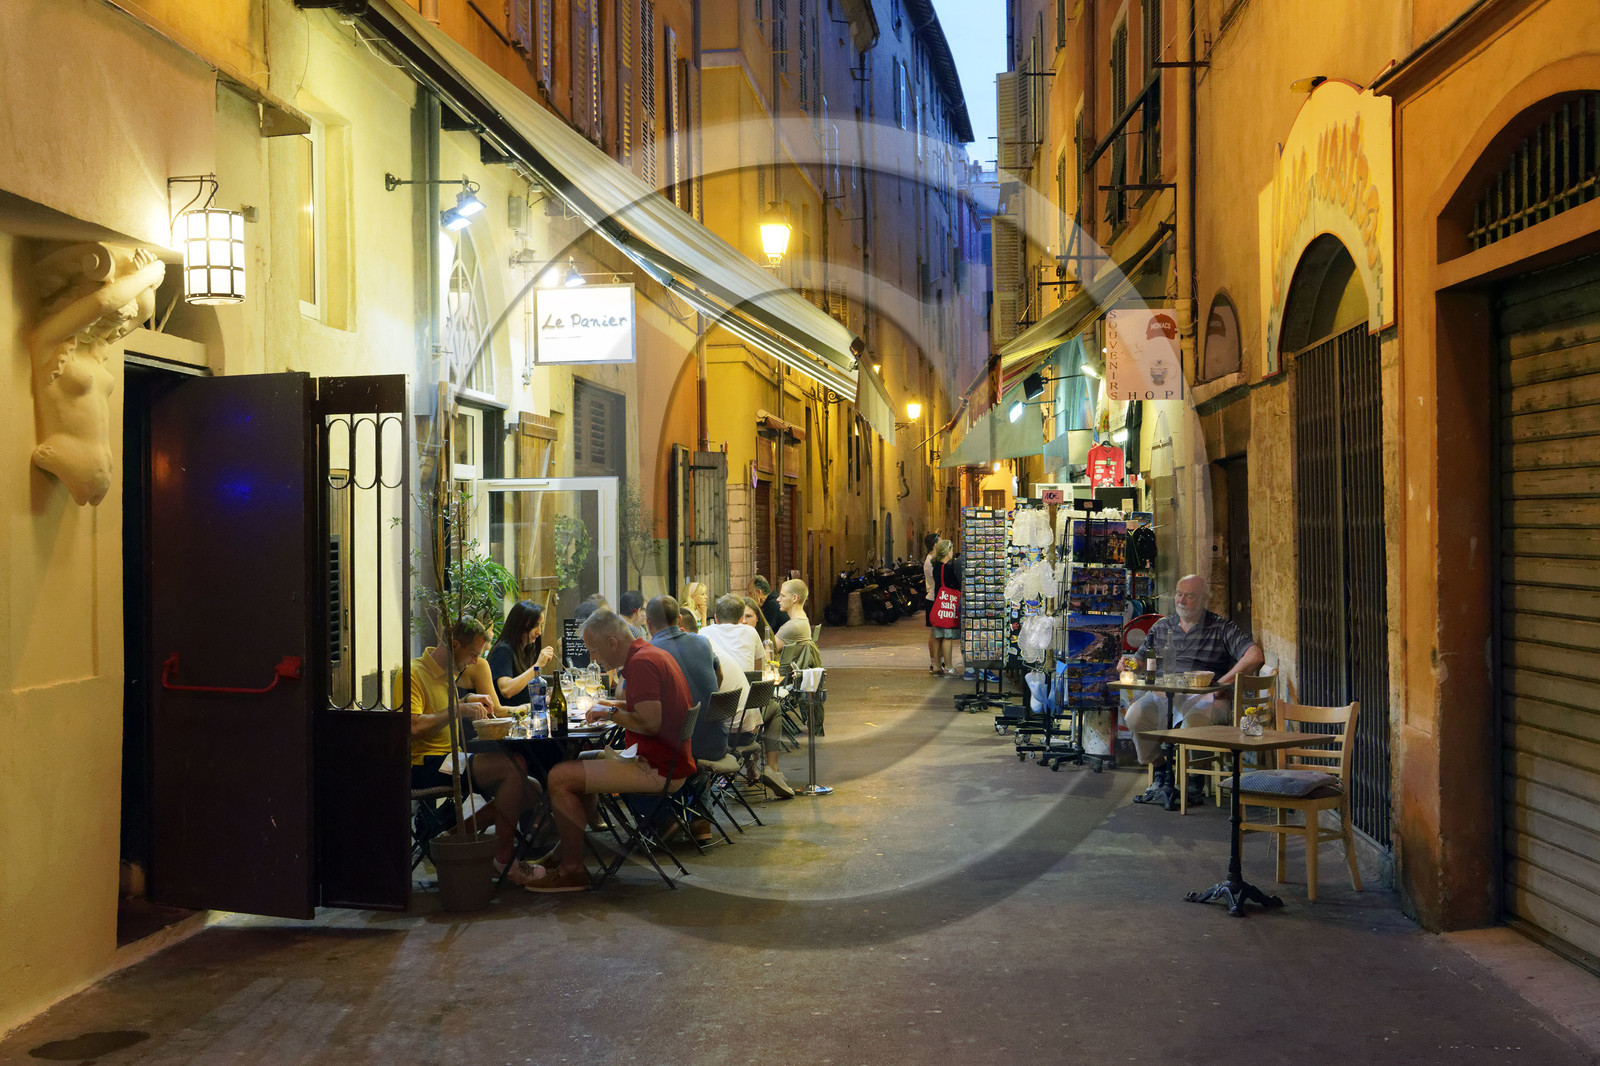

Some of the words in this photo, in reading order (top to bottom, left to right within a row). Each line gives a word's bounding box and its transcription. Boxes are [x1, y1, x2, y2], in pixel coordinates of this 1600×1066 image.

[541, 313, 565, 331] Le
[569, 312, 628, 329] Panier
[1108, 310, 1119, 400] SOUVENIRS
[1082, 583, 1118, 596] NICE
[939, 590, 949, 601] Je
[950, 594, 958, 603] ne
[940, 600, 956, 610] sais
